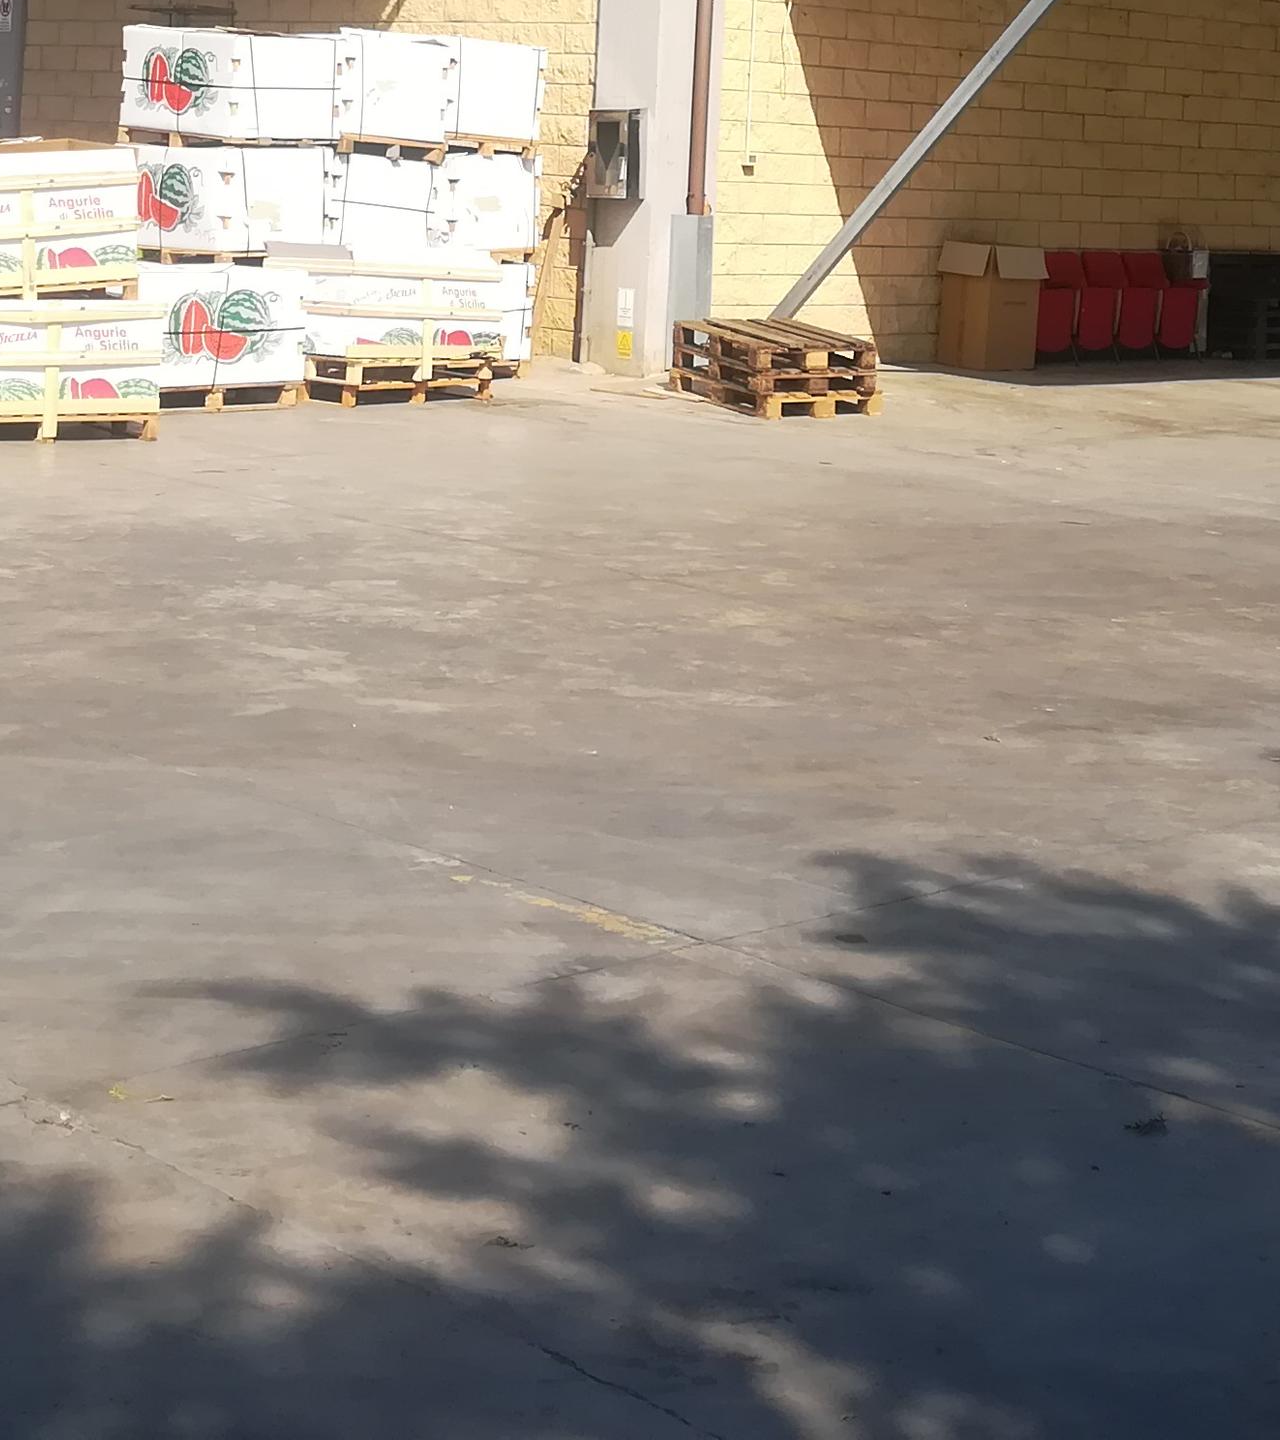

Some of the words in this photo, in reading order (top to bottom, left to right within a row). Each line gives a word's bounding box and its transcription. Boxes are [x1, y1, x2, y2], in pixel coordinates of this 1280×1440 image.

[48, 196, 101, 209] Angurie
[74, 208, 115, 220] Sicilia
[75, 326, 127, 340] Angurie
[100, 339, 139, 351] Sicilia
